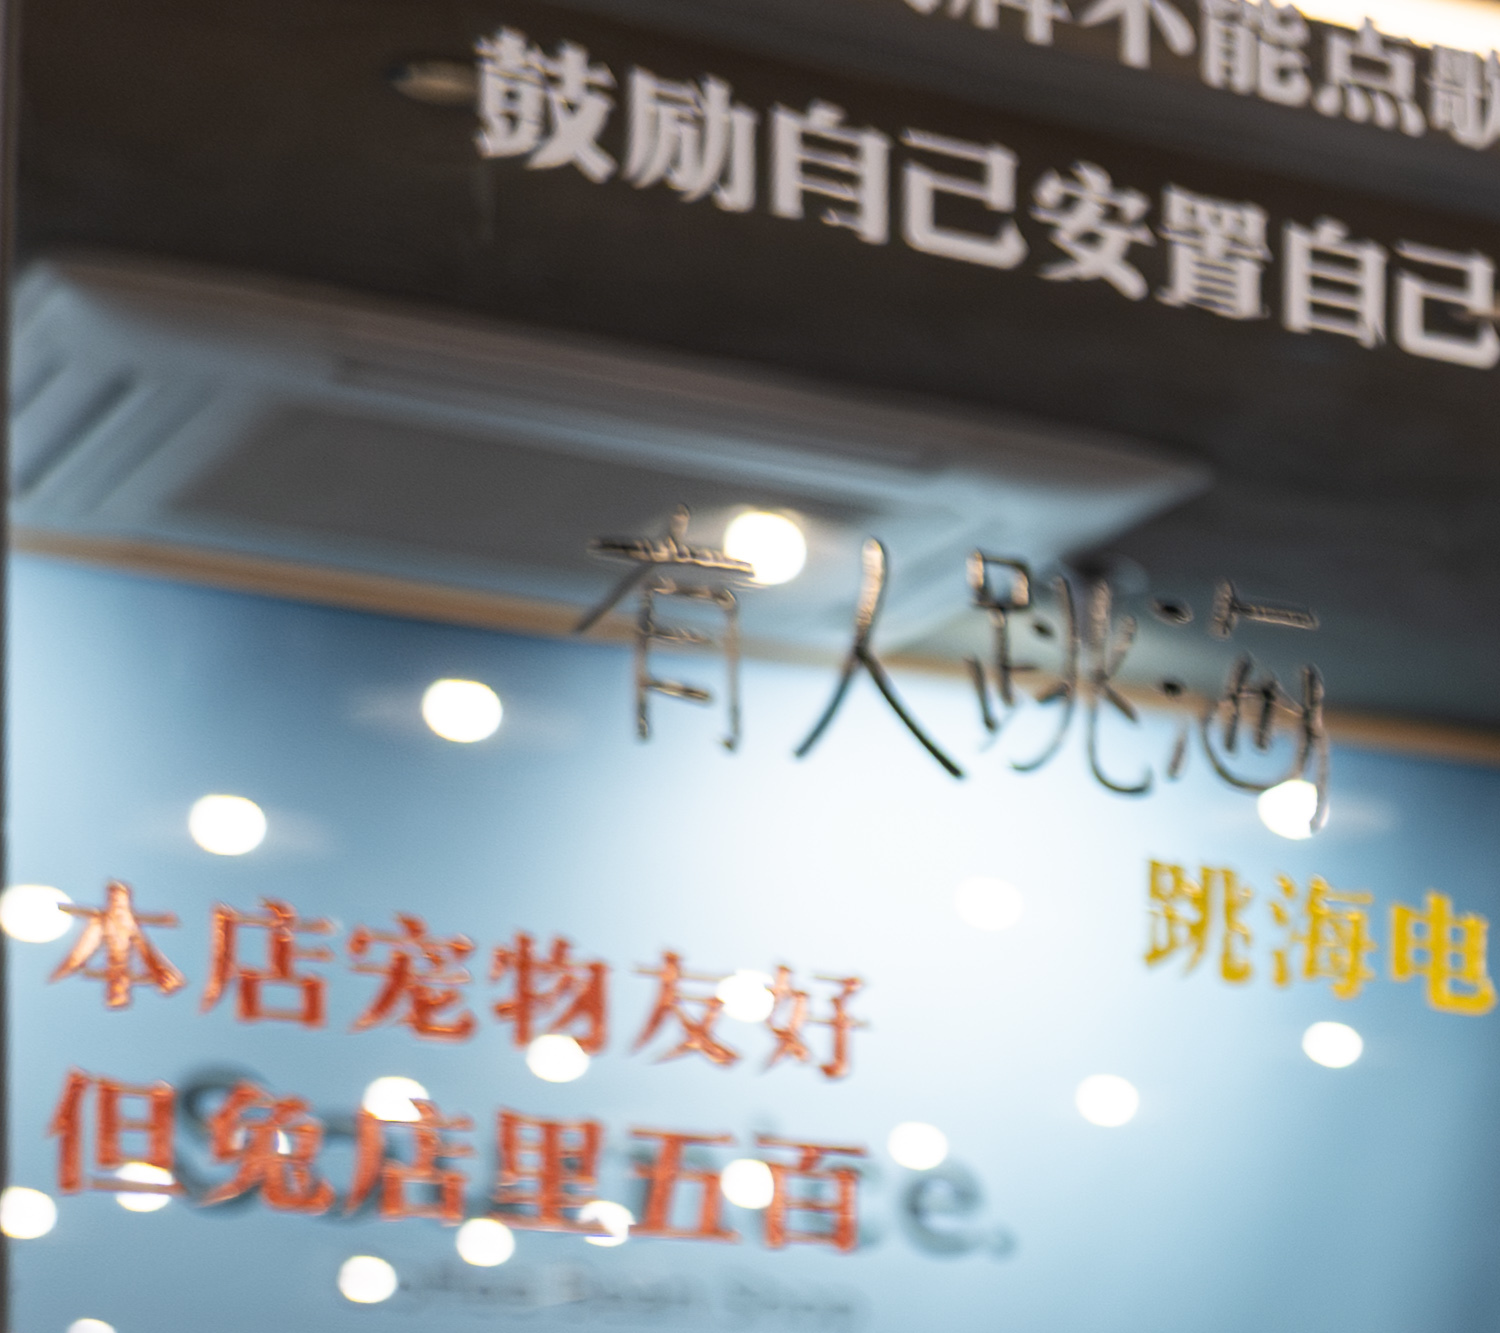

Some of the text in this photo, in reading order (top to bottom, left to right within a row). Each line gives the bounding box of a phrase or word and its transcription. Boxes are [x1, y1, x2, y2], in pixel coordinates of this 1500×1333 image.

[575, 503, 1332, 835] 有人跳海
[48, 878, 870, 1080] 本店宠物友好
